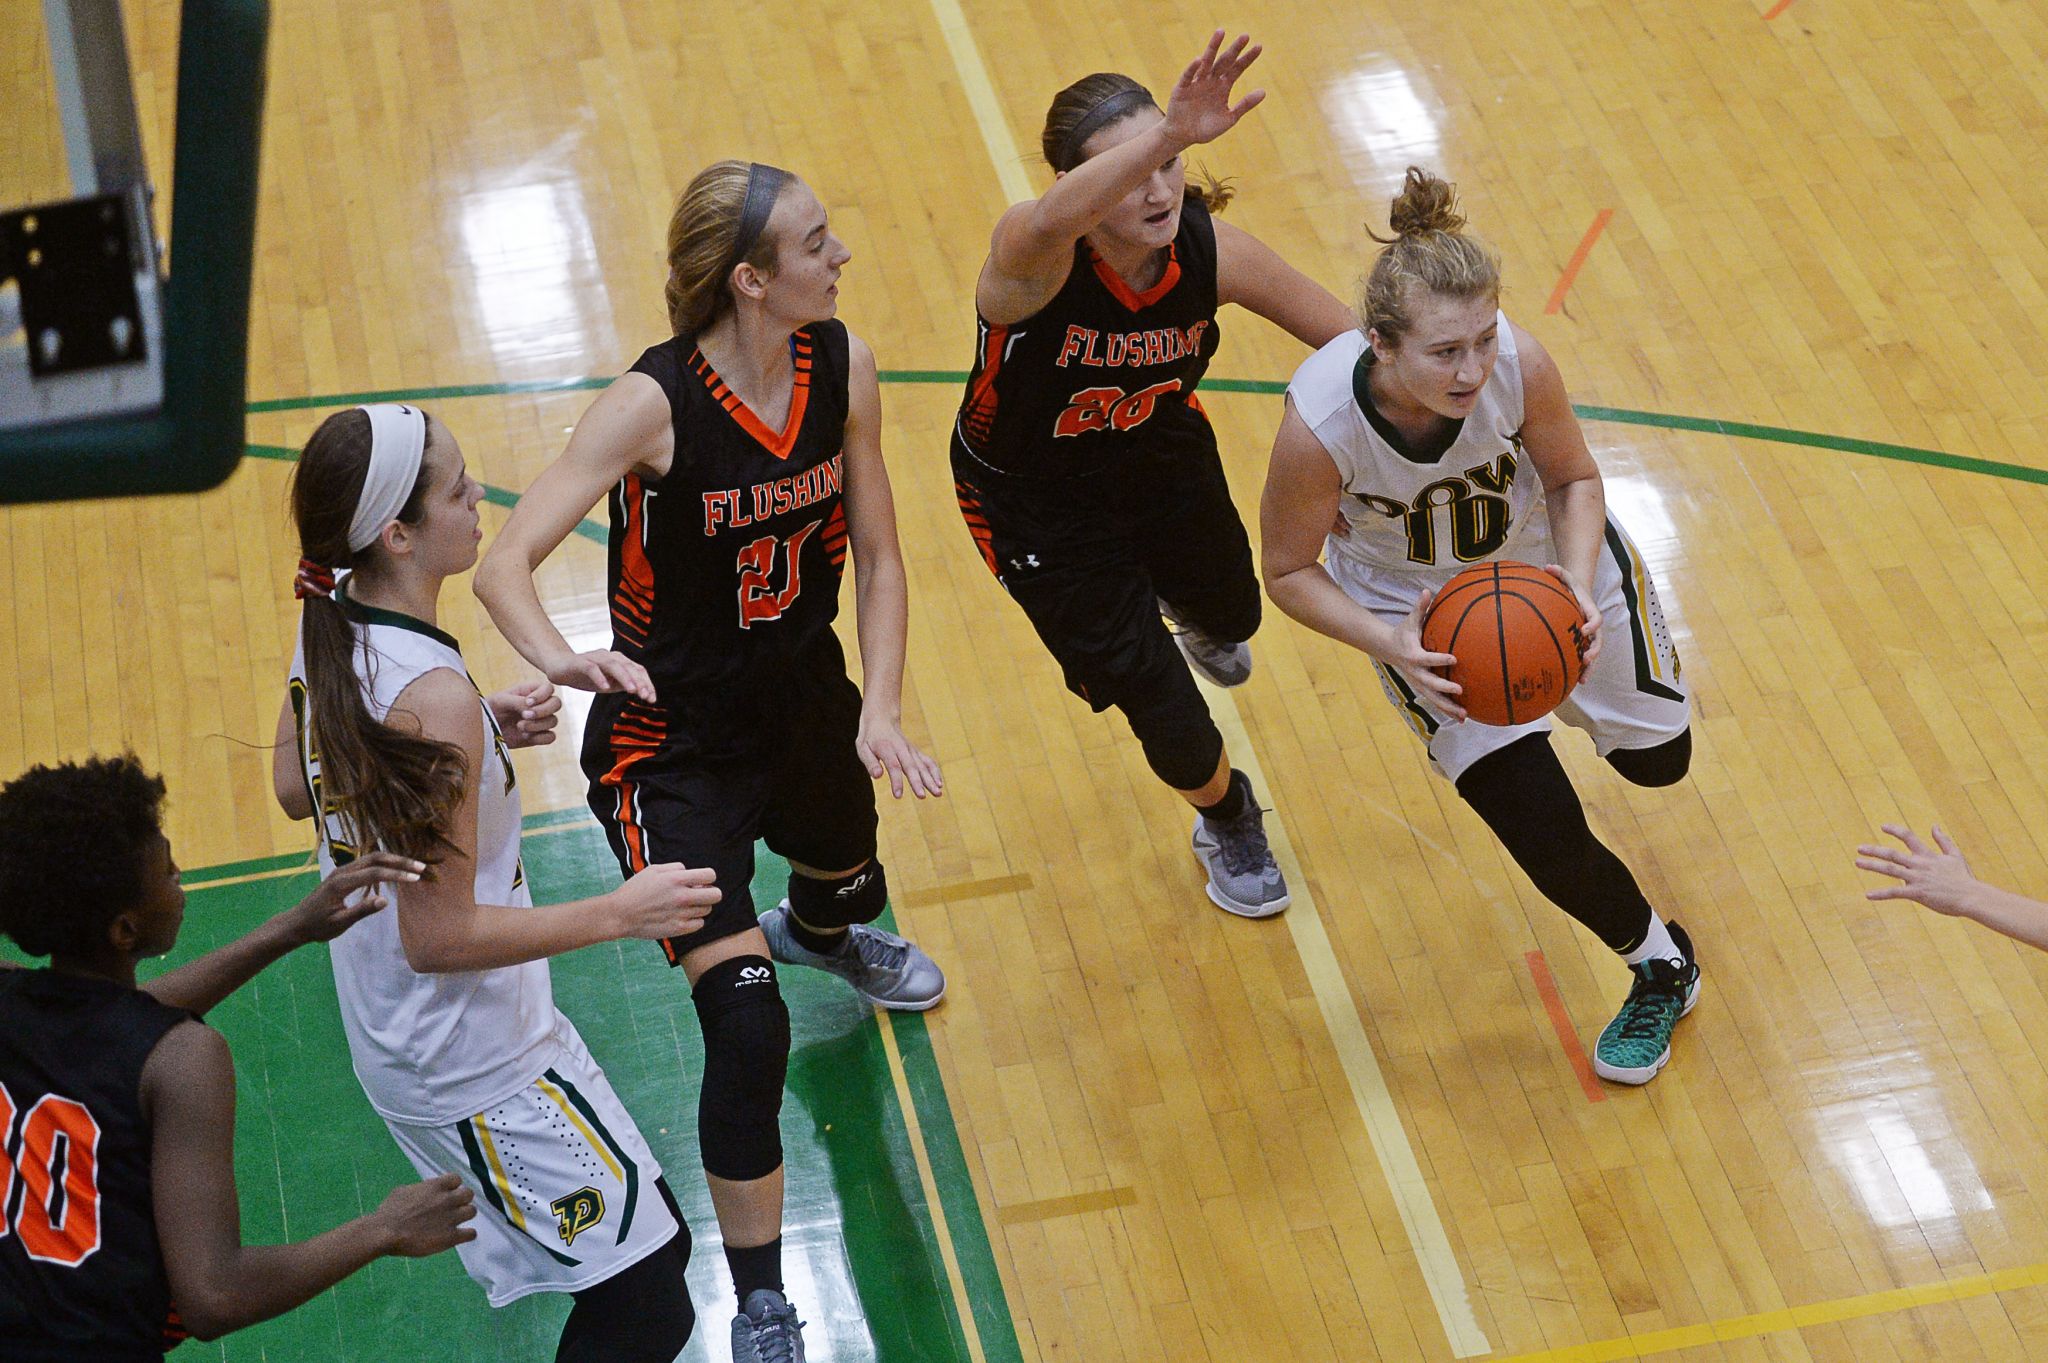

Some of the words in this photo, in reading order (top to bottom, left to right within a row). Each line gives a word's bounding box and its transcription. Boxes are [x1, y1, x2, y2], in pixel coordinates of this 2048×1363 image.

[1053, 378, 1182, 438] 20
[702, 449, 844, 537] FLUSHIN
[1404, 494, 1511, 566] 10
[736, 519, 823, 630] 21
